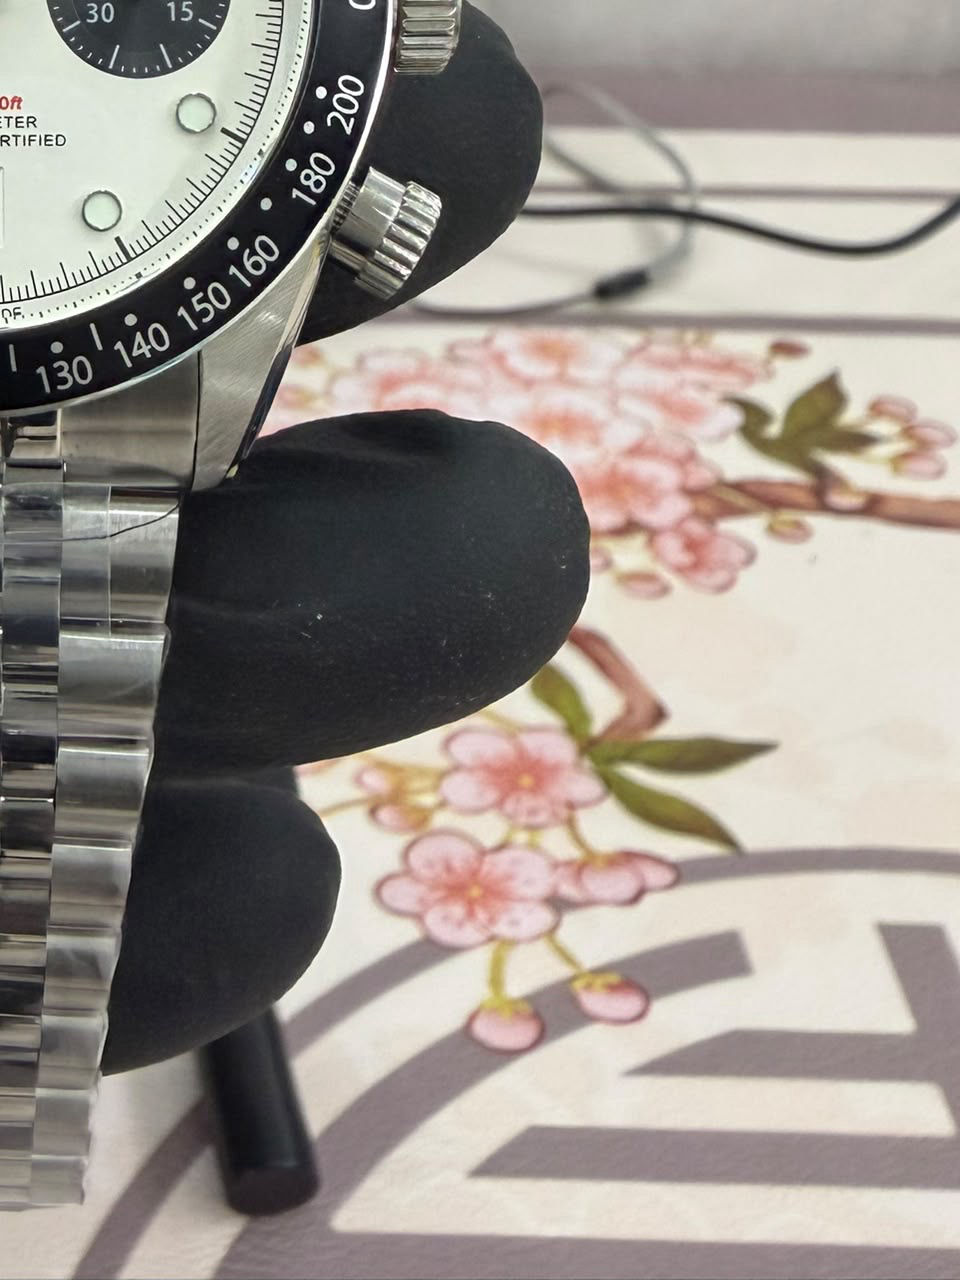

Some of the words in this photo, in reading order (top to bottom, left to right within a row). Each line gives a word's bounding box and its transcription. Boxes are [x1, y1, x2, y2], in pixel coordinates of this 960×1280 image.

[86, 2, 115, 23] 30
[167, 1, 193, 21] 15
[327, 74, 365, 135] 200
[292, 152, 335, 206] 180
[229, 235, 279, 287] 160
[177, 281, 231, 331] 150
[113, 322, 171, 368] 140
[36, 355, 93, 394] 130
